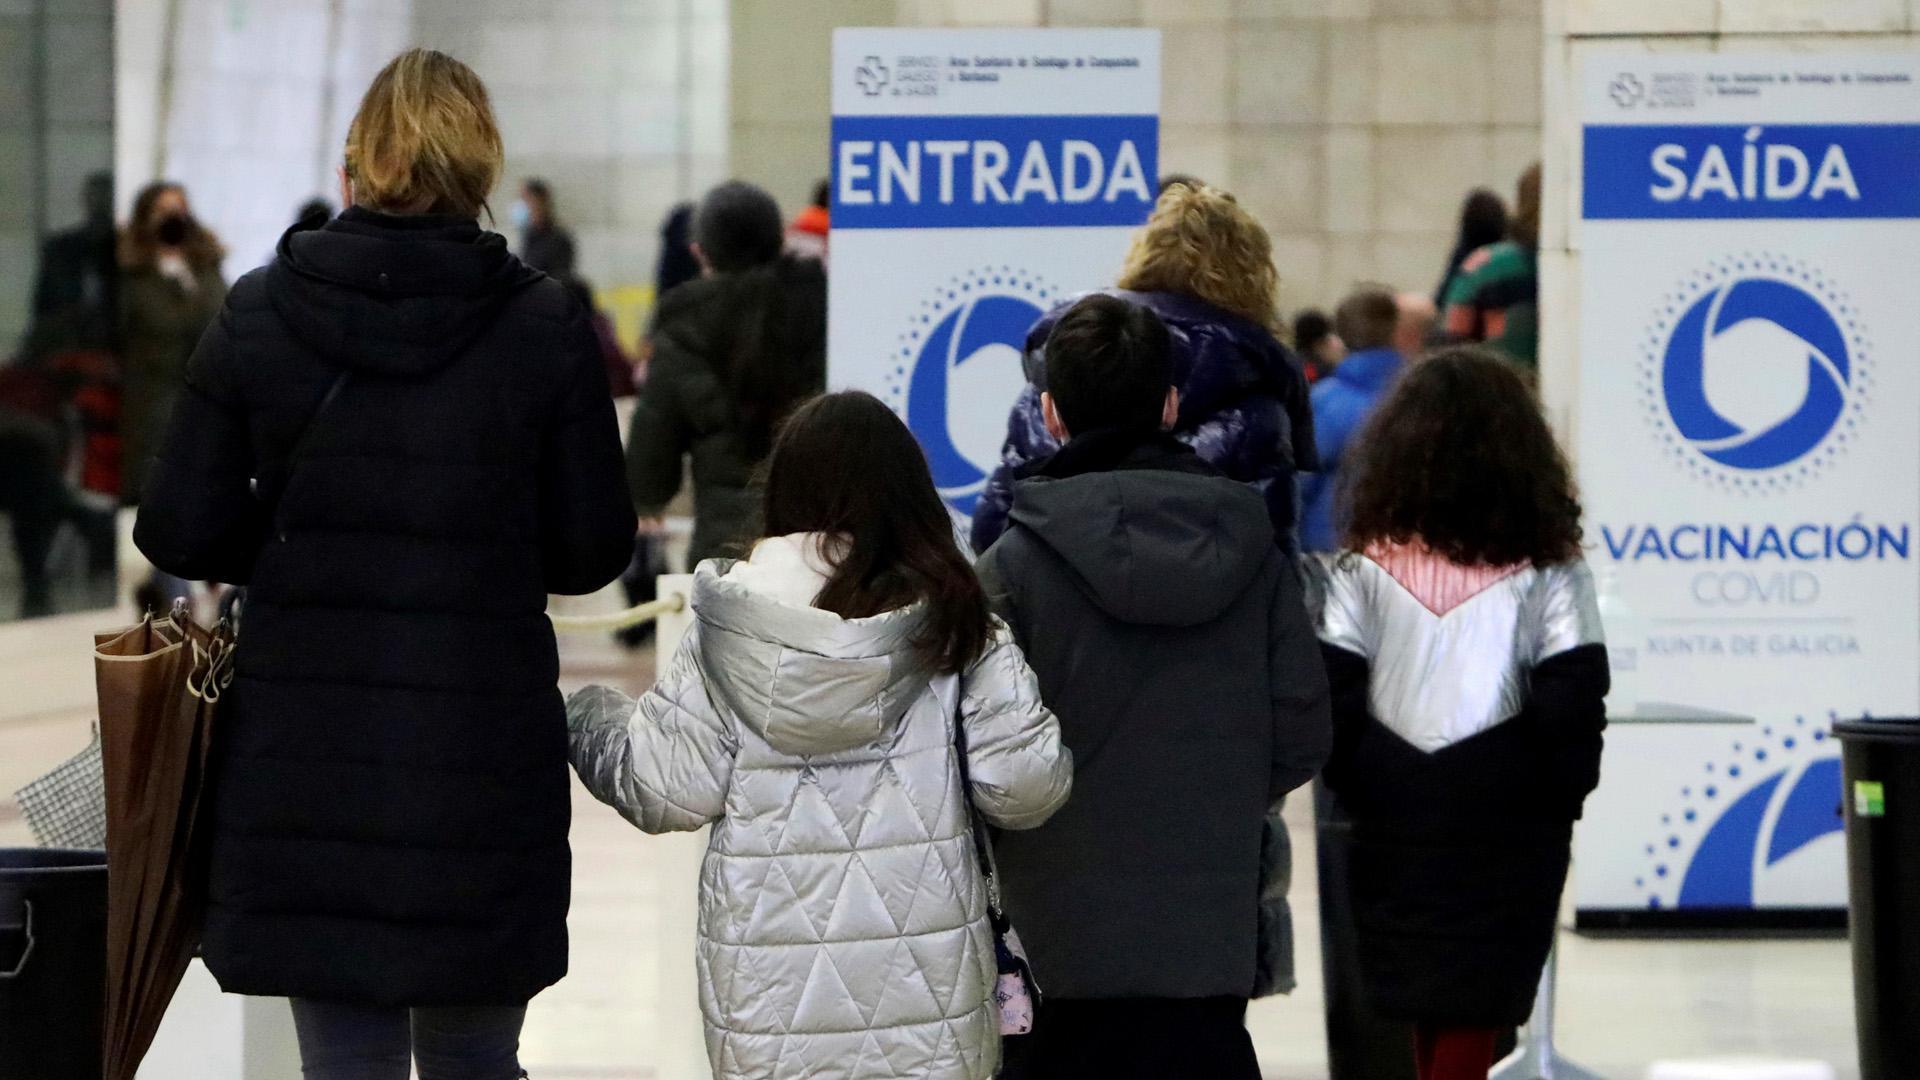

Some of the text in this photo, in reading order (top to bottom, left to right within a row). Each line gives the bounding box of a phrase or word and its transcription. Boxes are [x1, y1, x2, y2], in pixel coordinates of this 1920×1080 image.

[839, 139, 1151, 204] ENTRADA
[1650, 126, 1861, 201] SAÍDA
[1601, 513, 1910, 560] VACINACIÓN
[1691, 570, 1820, 607] COVID
[1647, 634, 1860, 655] XUNTA DE GALICIA
